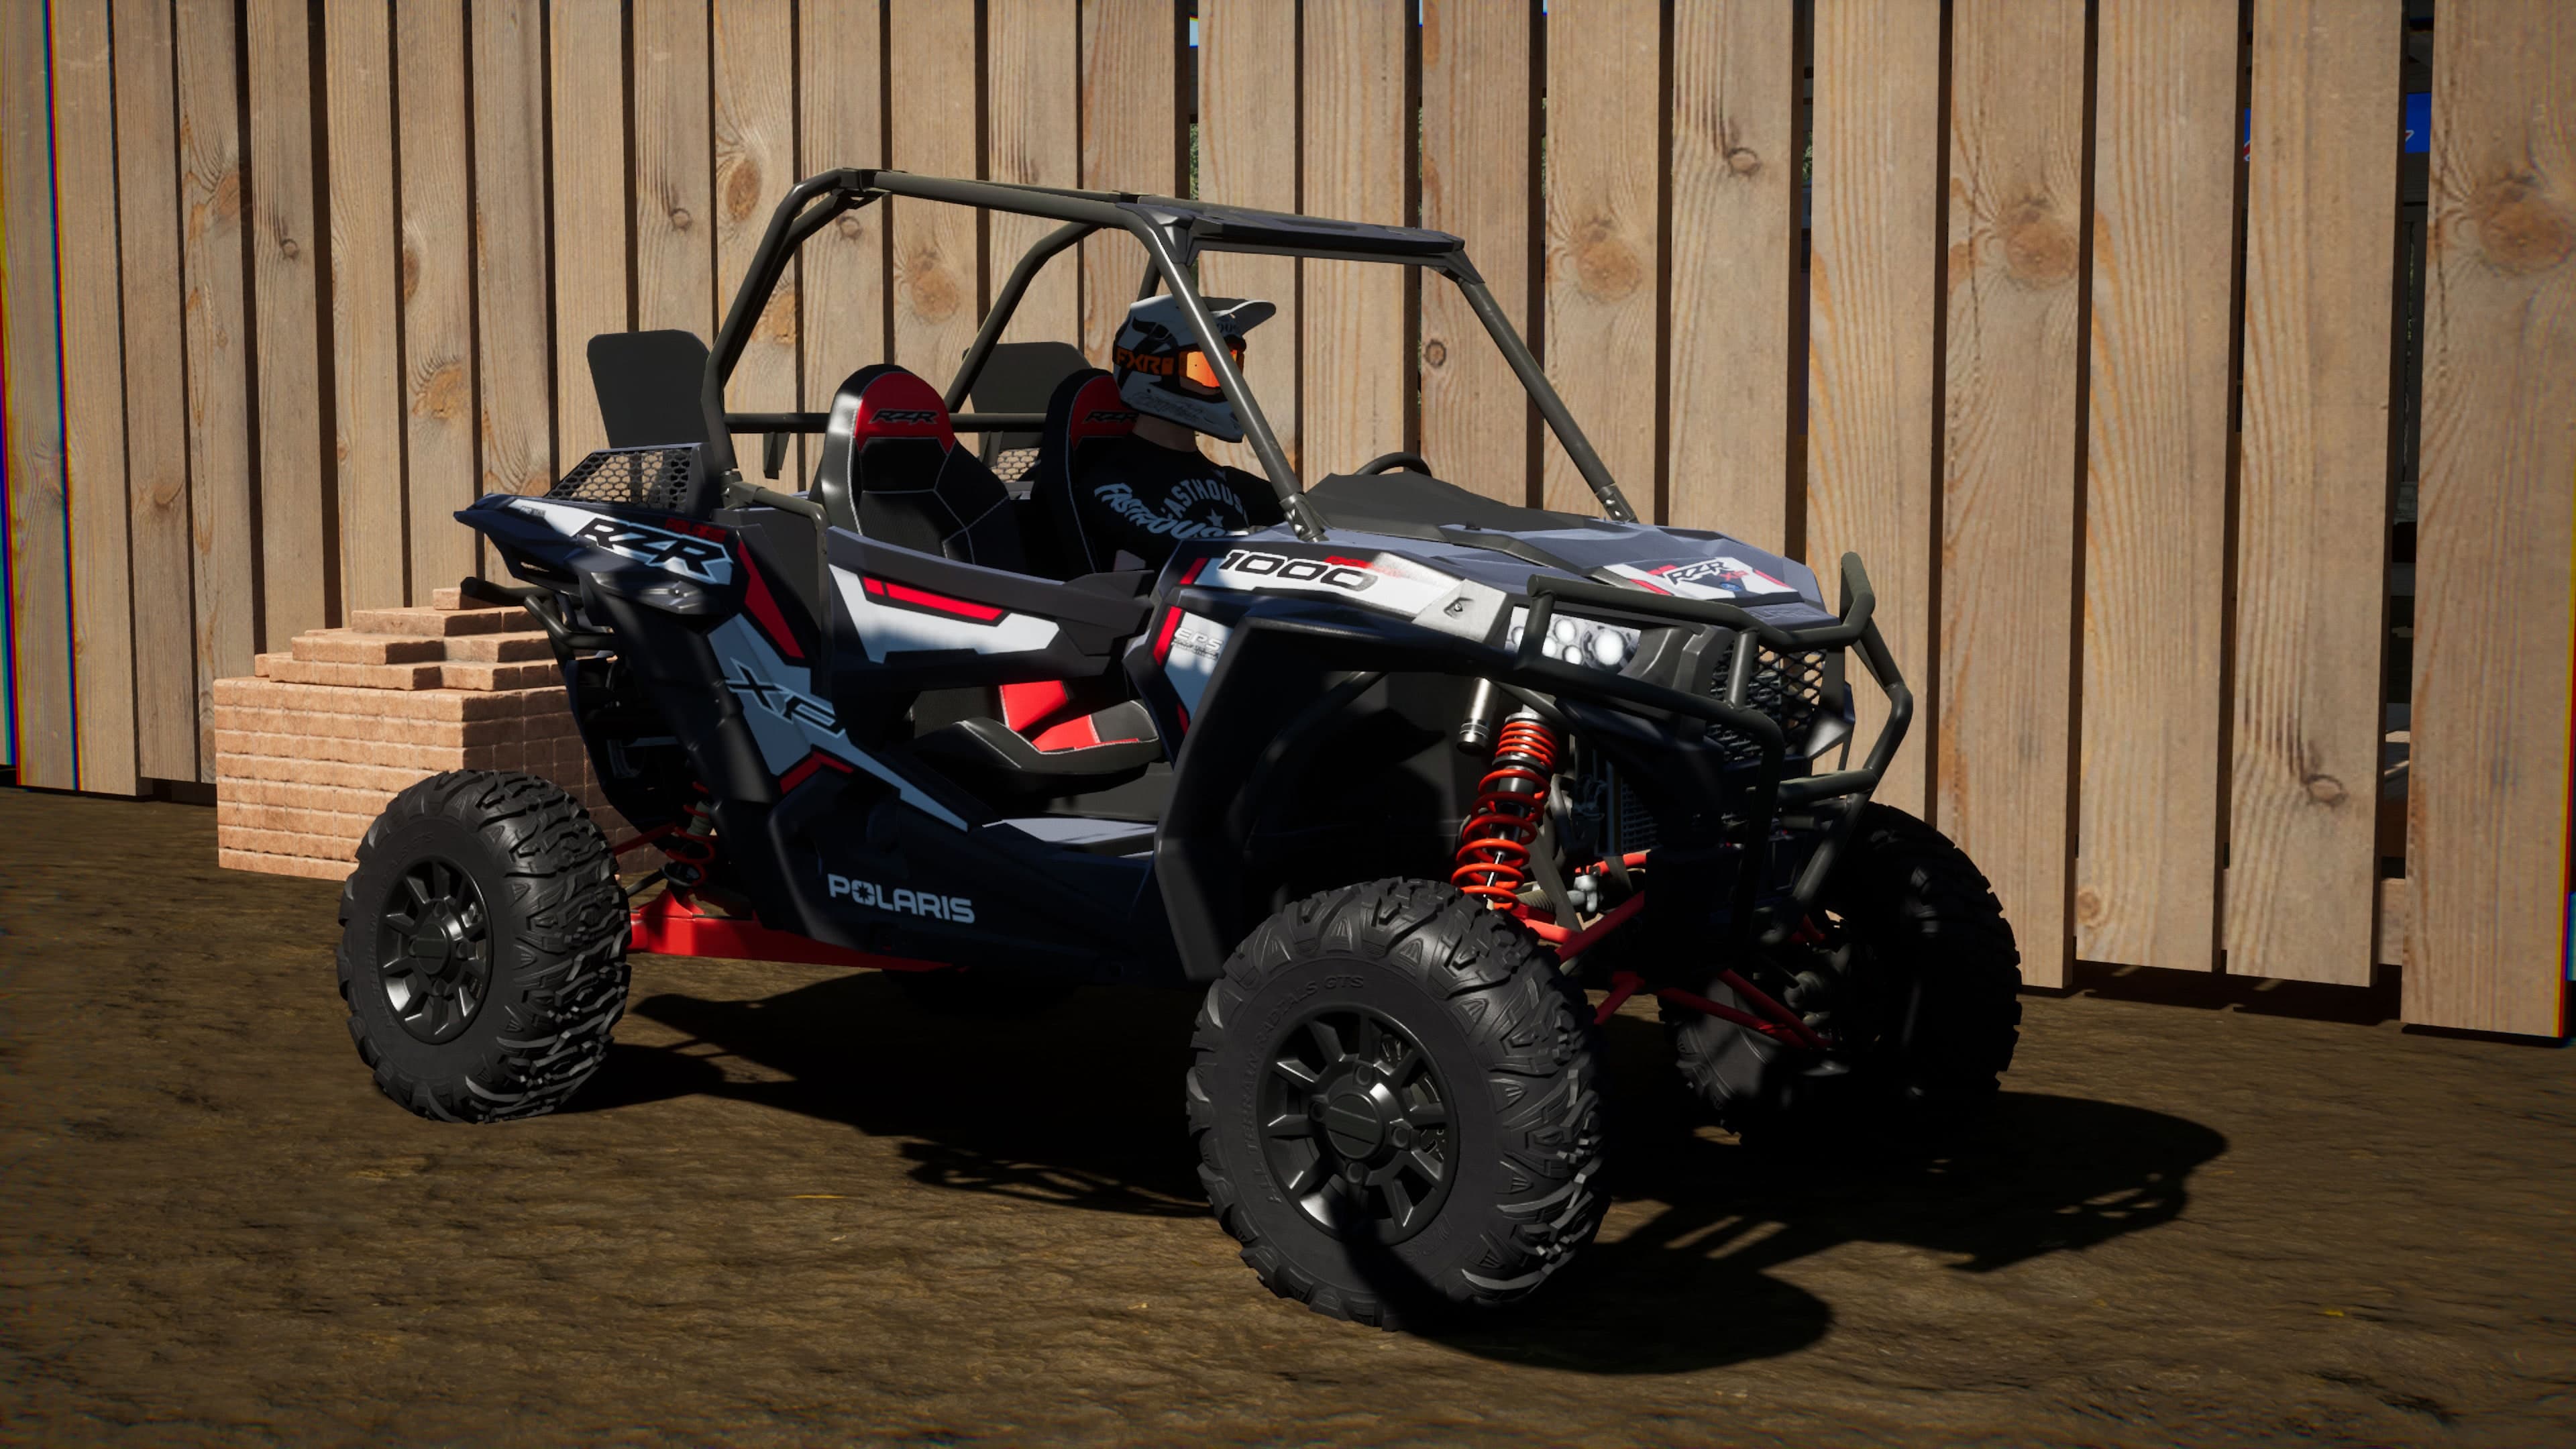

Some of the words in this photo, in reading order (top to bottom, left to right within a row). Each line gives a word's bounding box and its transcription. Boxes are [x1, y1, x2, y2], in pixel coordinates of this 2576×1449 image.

[1116, 346, 1159, 376] FXR
[868, 409, 938, 425] RZR
[1094, 482, 1226, 539] FASTHOUS
[1161, 478, 1250, 527] ASTHOUS
[578, 516, 729, 581] RZR
[1218, 549, 1378, 592] 1000
[1664, 560, 1729, 586] RZR
[1174, 628, 1222, 651] EPS
[724, 657, 846, 737] XP
[827, 873, 976, 924] POLARIS
[1324, 975, 1364, 989] GTS
